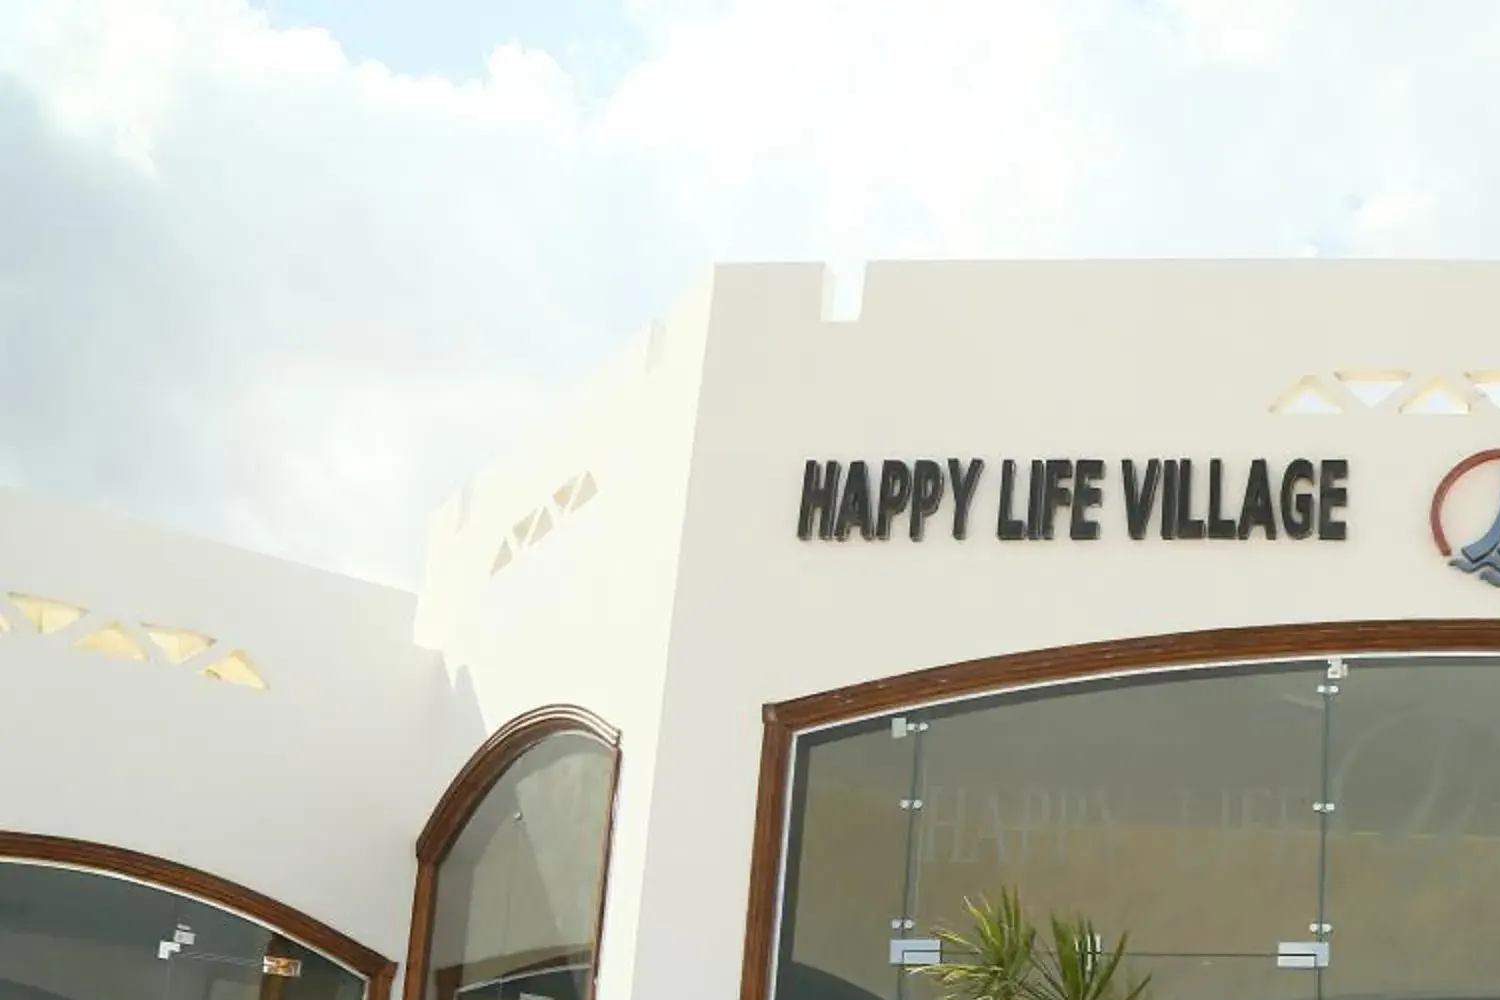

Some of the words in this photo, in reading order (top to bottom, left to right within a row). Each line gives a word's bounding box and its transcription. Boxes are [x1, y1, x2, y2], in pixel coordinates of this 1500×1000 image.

[797, 458, 984, 542] HAPPY
[997, 459, 1105, 541] LIFE
[1122, 458, 1348, 541] VILLAGE
